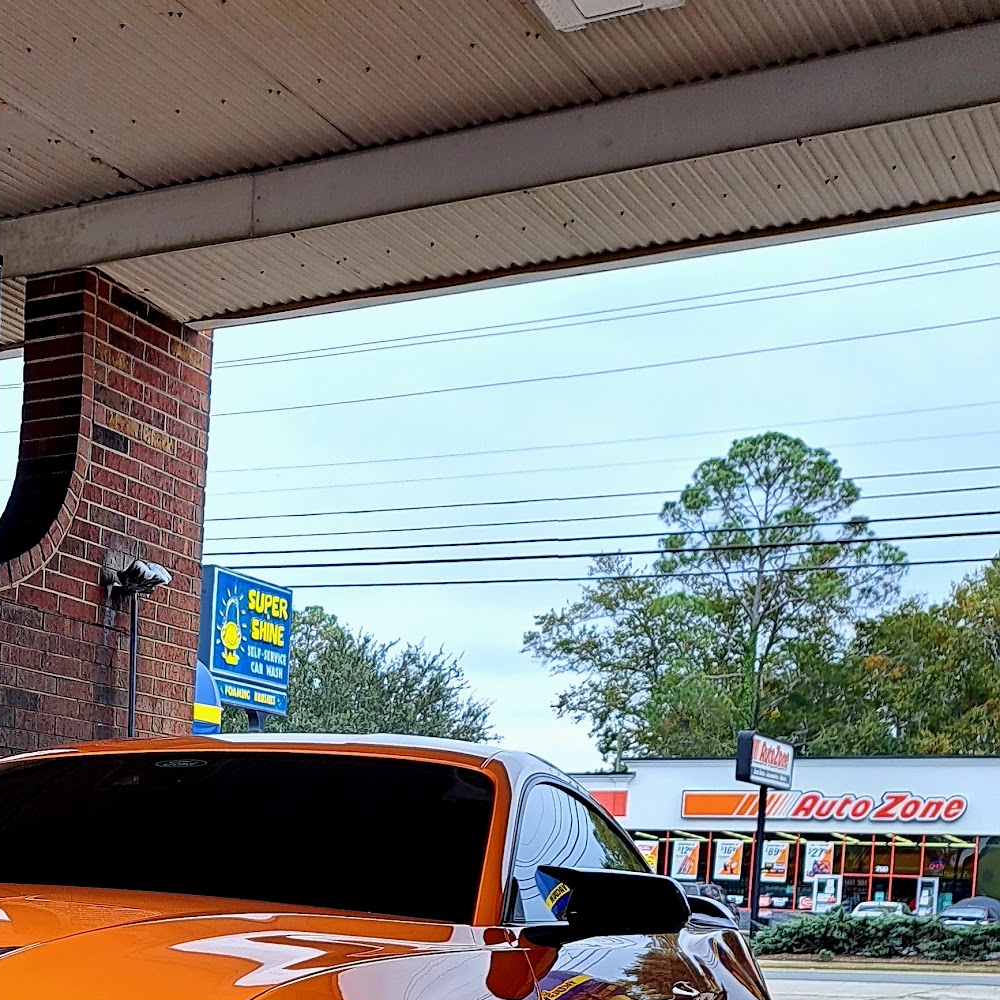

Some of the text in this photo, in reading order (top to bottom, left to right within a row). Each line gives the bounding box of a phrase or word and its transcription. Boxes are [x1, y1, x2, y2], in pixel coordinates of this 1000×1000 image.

[248, 589, 288, 620] SUPER
[251, 618, 285, 646] SHINE
[250, 661, 283, 679] CAR WASH
[224, 685, 251, 700] FOAMING
[760, 740, 789, 768] AutoZone
[790, 793, 965, 819] AutoZone
